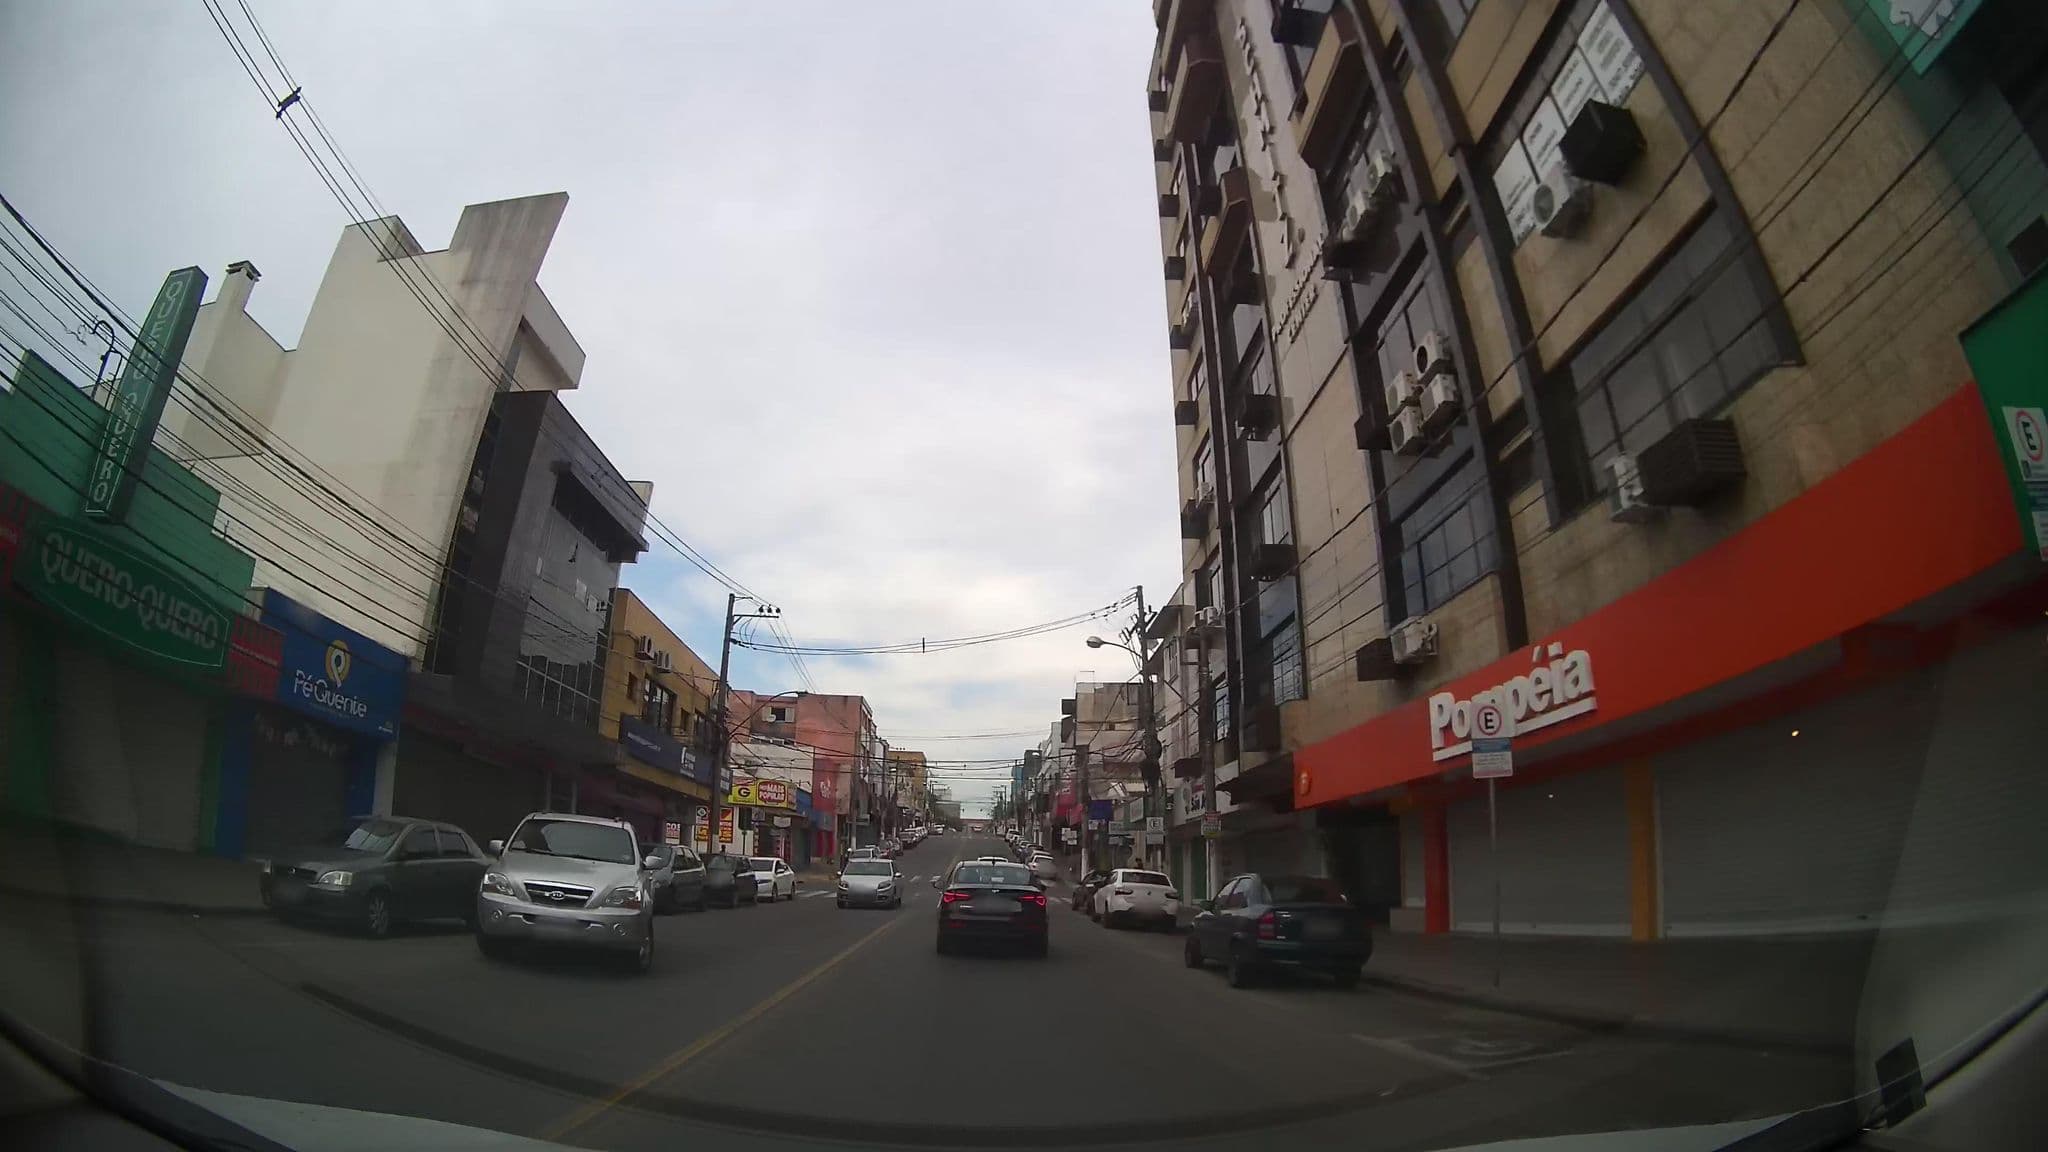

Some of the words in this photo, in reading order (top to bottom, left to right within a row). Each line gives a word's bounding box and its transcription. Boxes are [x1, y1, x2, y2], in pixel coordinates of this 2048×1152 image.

[130, 279, 180, 383] QUERO
[92, 390, 143, 504] QUERO
[2021, 420, 2038, 452] E
[1484, 712, 1495, 729] E
[738, 787, 751, 798] G
[767, 783, 785, 793] MAIS
